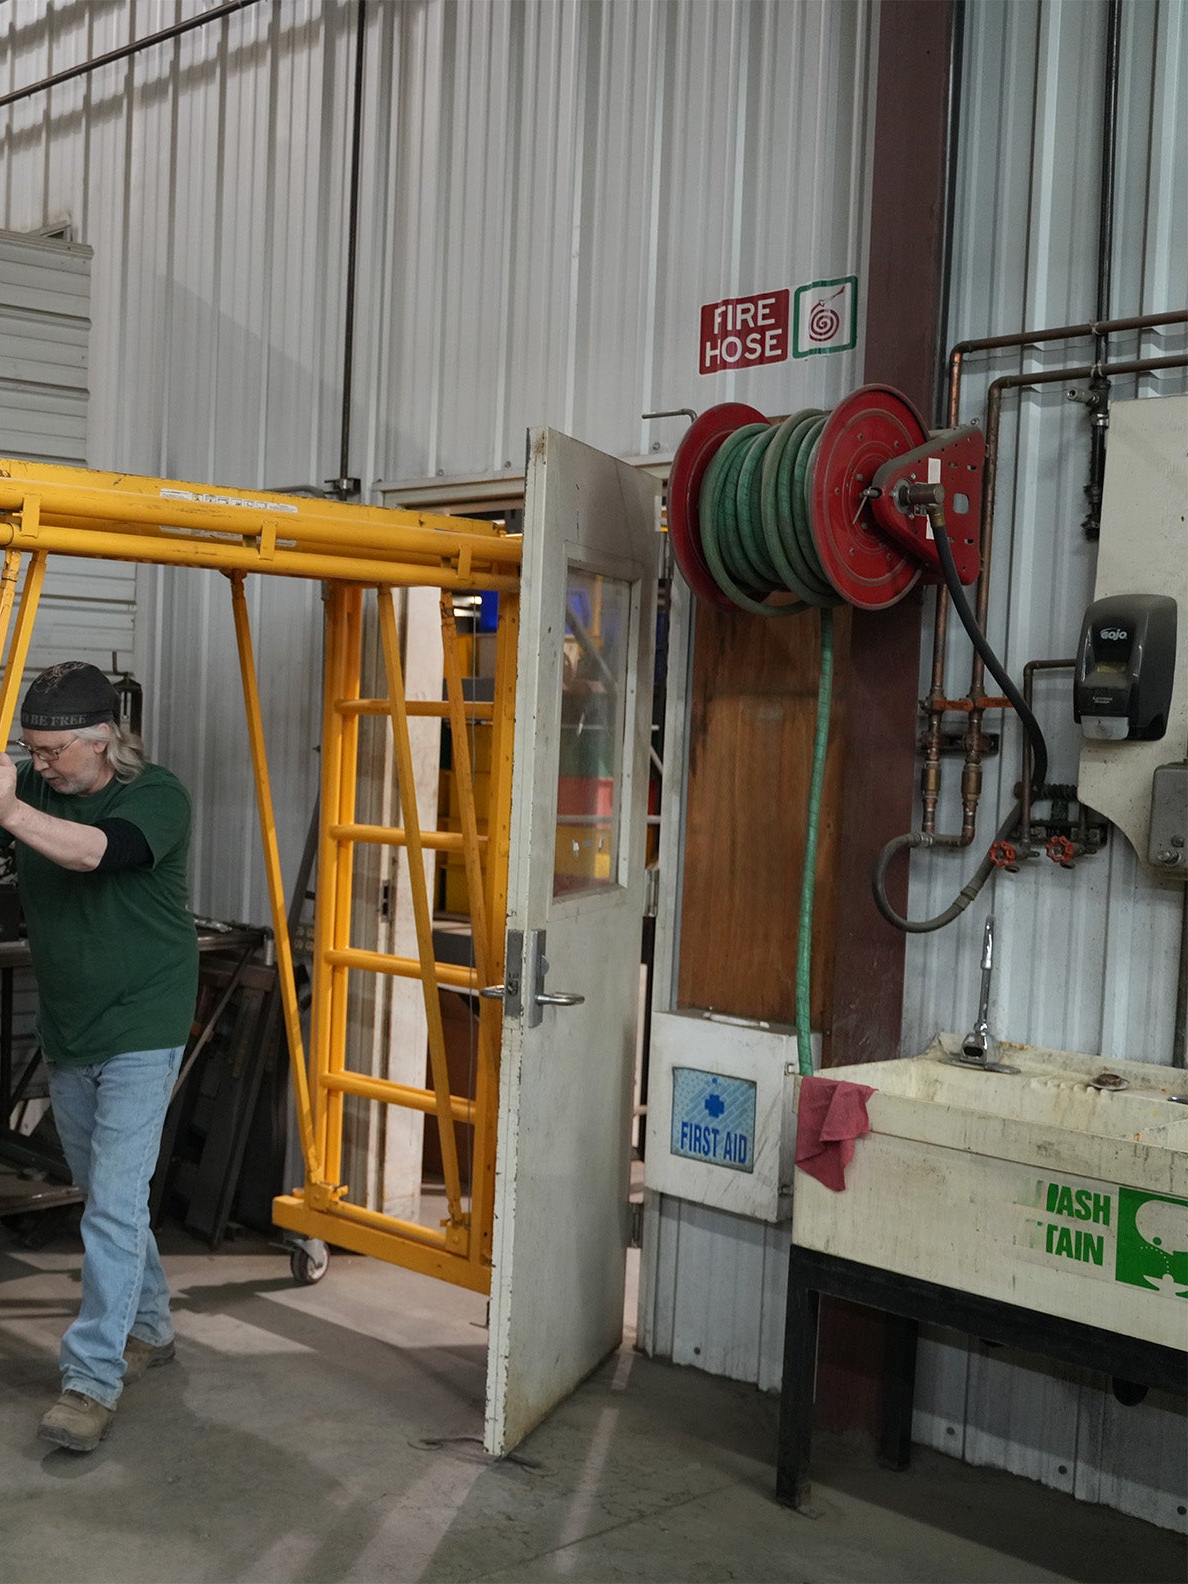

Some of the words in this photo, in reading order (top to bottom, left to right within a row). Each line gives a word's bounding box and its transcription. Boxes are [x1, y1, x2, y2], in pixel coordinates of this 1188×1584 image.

[714, 298, 775, 334] FIRE
[705, 329, 782, 367] HOSE
[31, 714, 48, 726] BE
[51, 715, 86, 726] FREE
[680, 1121, 719, 1157] FIRST
[723, 1131, 748, 1164] AID
